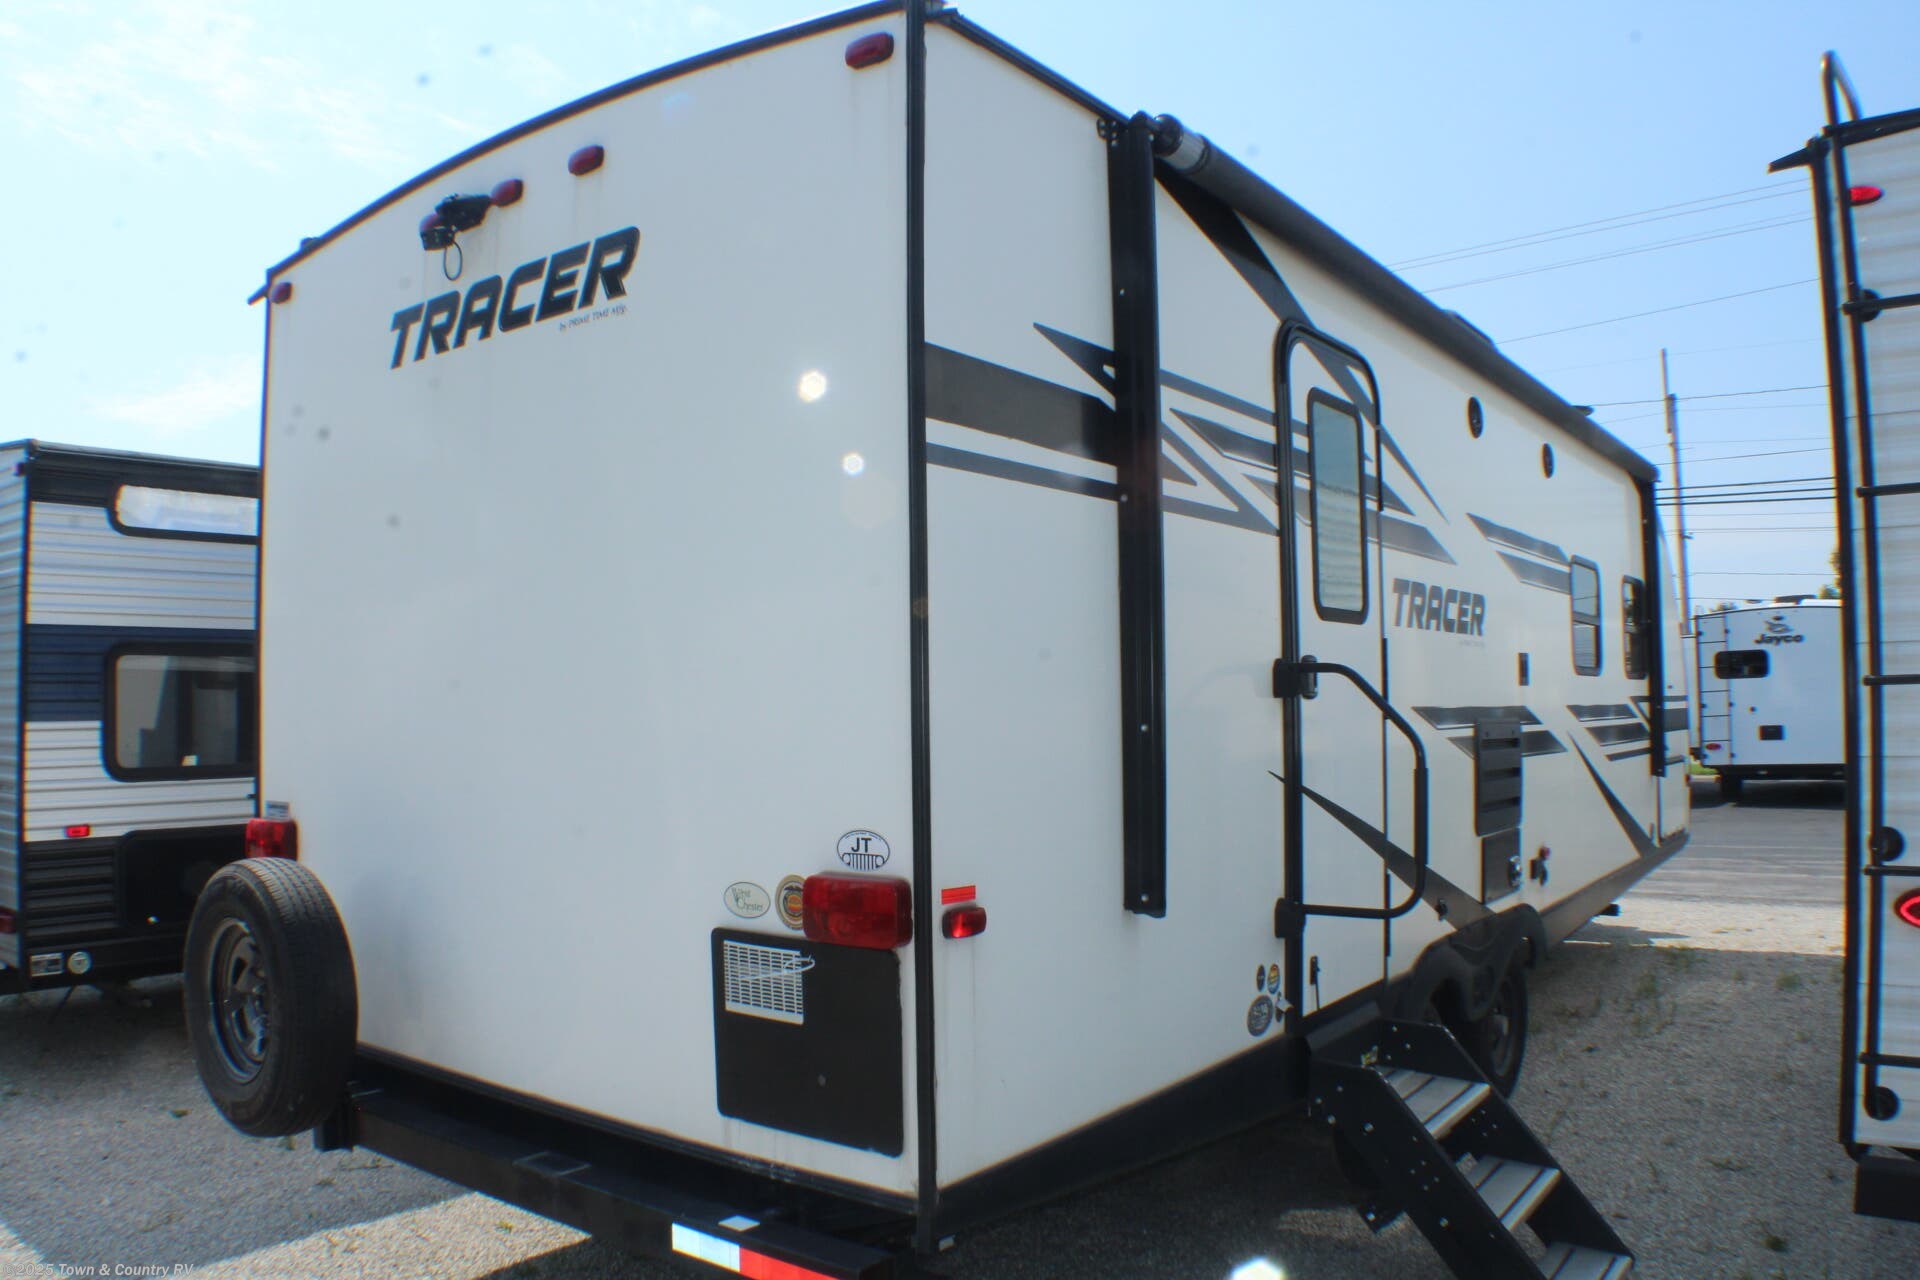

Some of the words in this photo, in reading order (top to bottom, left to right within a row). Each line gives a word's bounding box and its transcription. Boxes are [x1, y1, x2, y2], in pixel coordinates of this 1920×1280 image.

[390, 226, 641, 369] TRACER
[1392, 578, 1486, 637] TRACER
[1755, 634, 1804, 646] Jayco
[851, 837, 872, 853] JT
